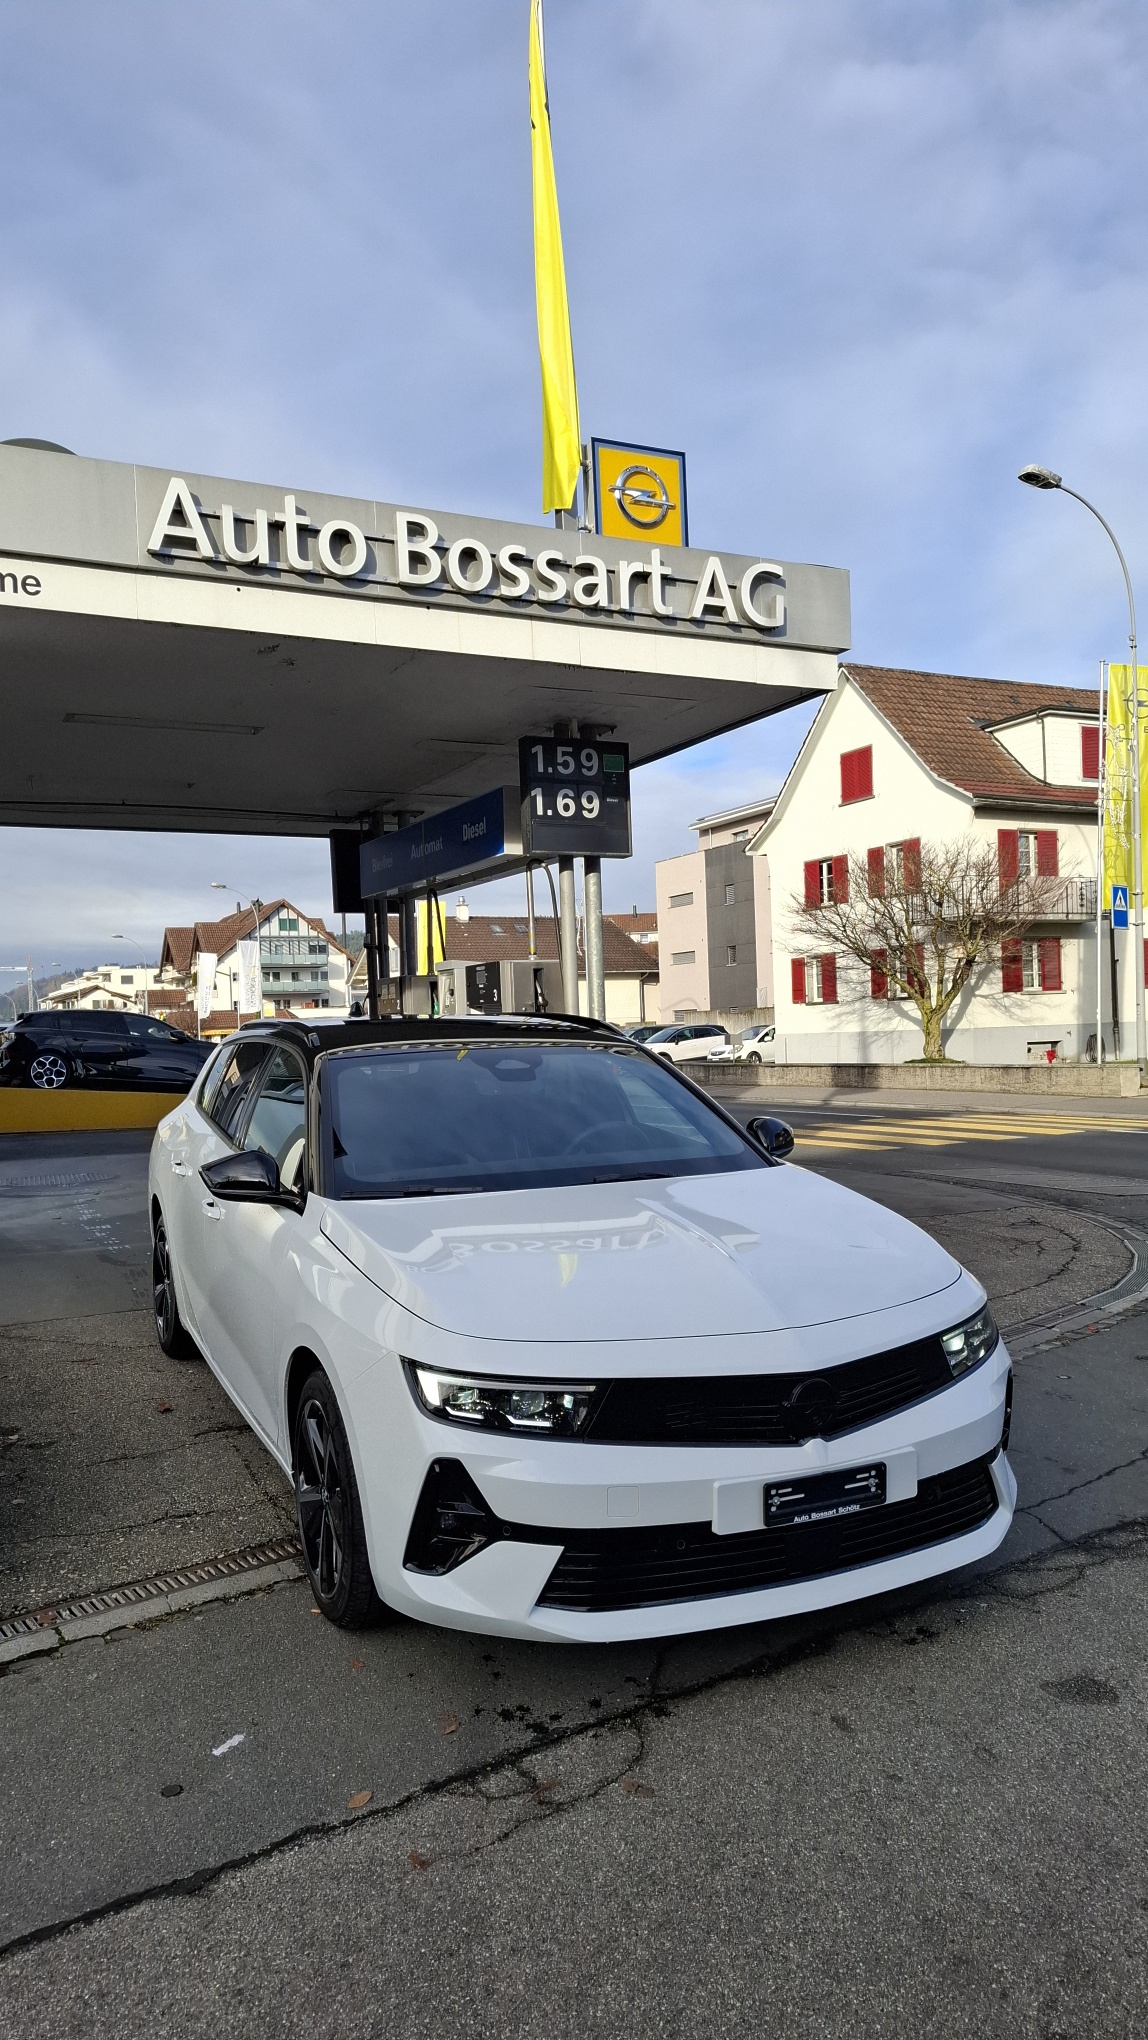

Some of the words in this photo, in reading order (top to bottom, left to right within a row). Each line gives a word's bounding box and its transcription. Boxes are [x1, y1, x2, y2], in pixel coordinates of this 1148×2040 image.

[147, 477, 367, 578] Auto
[395, 510, 673, 616] Bossart
[689, 556, 786, 629] AG
[531, 745, 599, 776] 1.59
[530, 787, 600, 819] 1.69
[410, 836, 443, 860] Automat
[462, 816, 487, 841] Diesel
[492, 988, 498, 1002] 3
[811, 1508, 837, 1519] Bossart
[838, 1504, 861, 1514] Schötz
